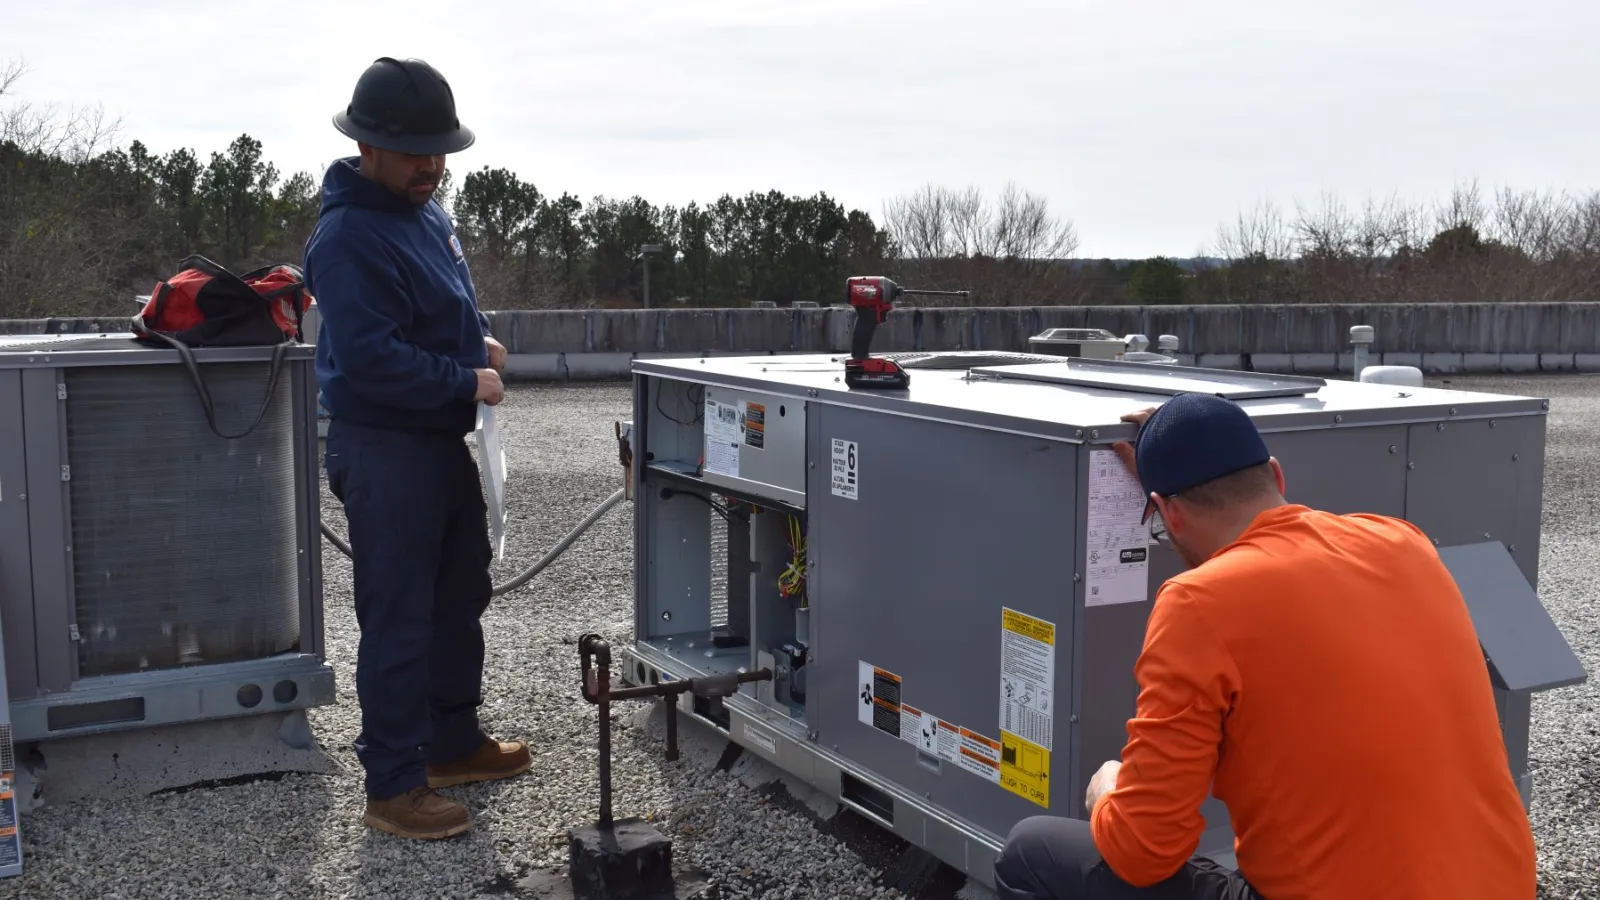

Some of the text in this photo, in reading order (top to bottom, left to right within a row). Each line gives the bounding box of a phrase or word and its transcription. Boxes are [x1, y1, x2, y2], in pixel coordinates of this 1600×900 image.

[848, 443, 855, 470] 6
[1000, 775, 1045, 801] FLUSH TO CURB
